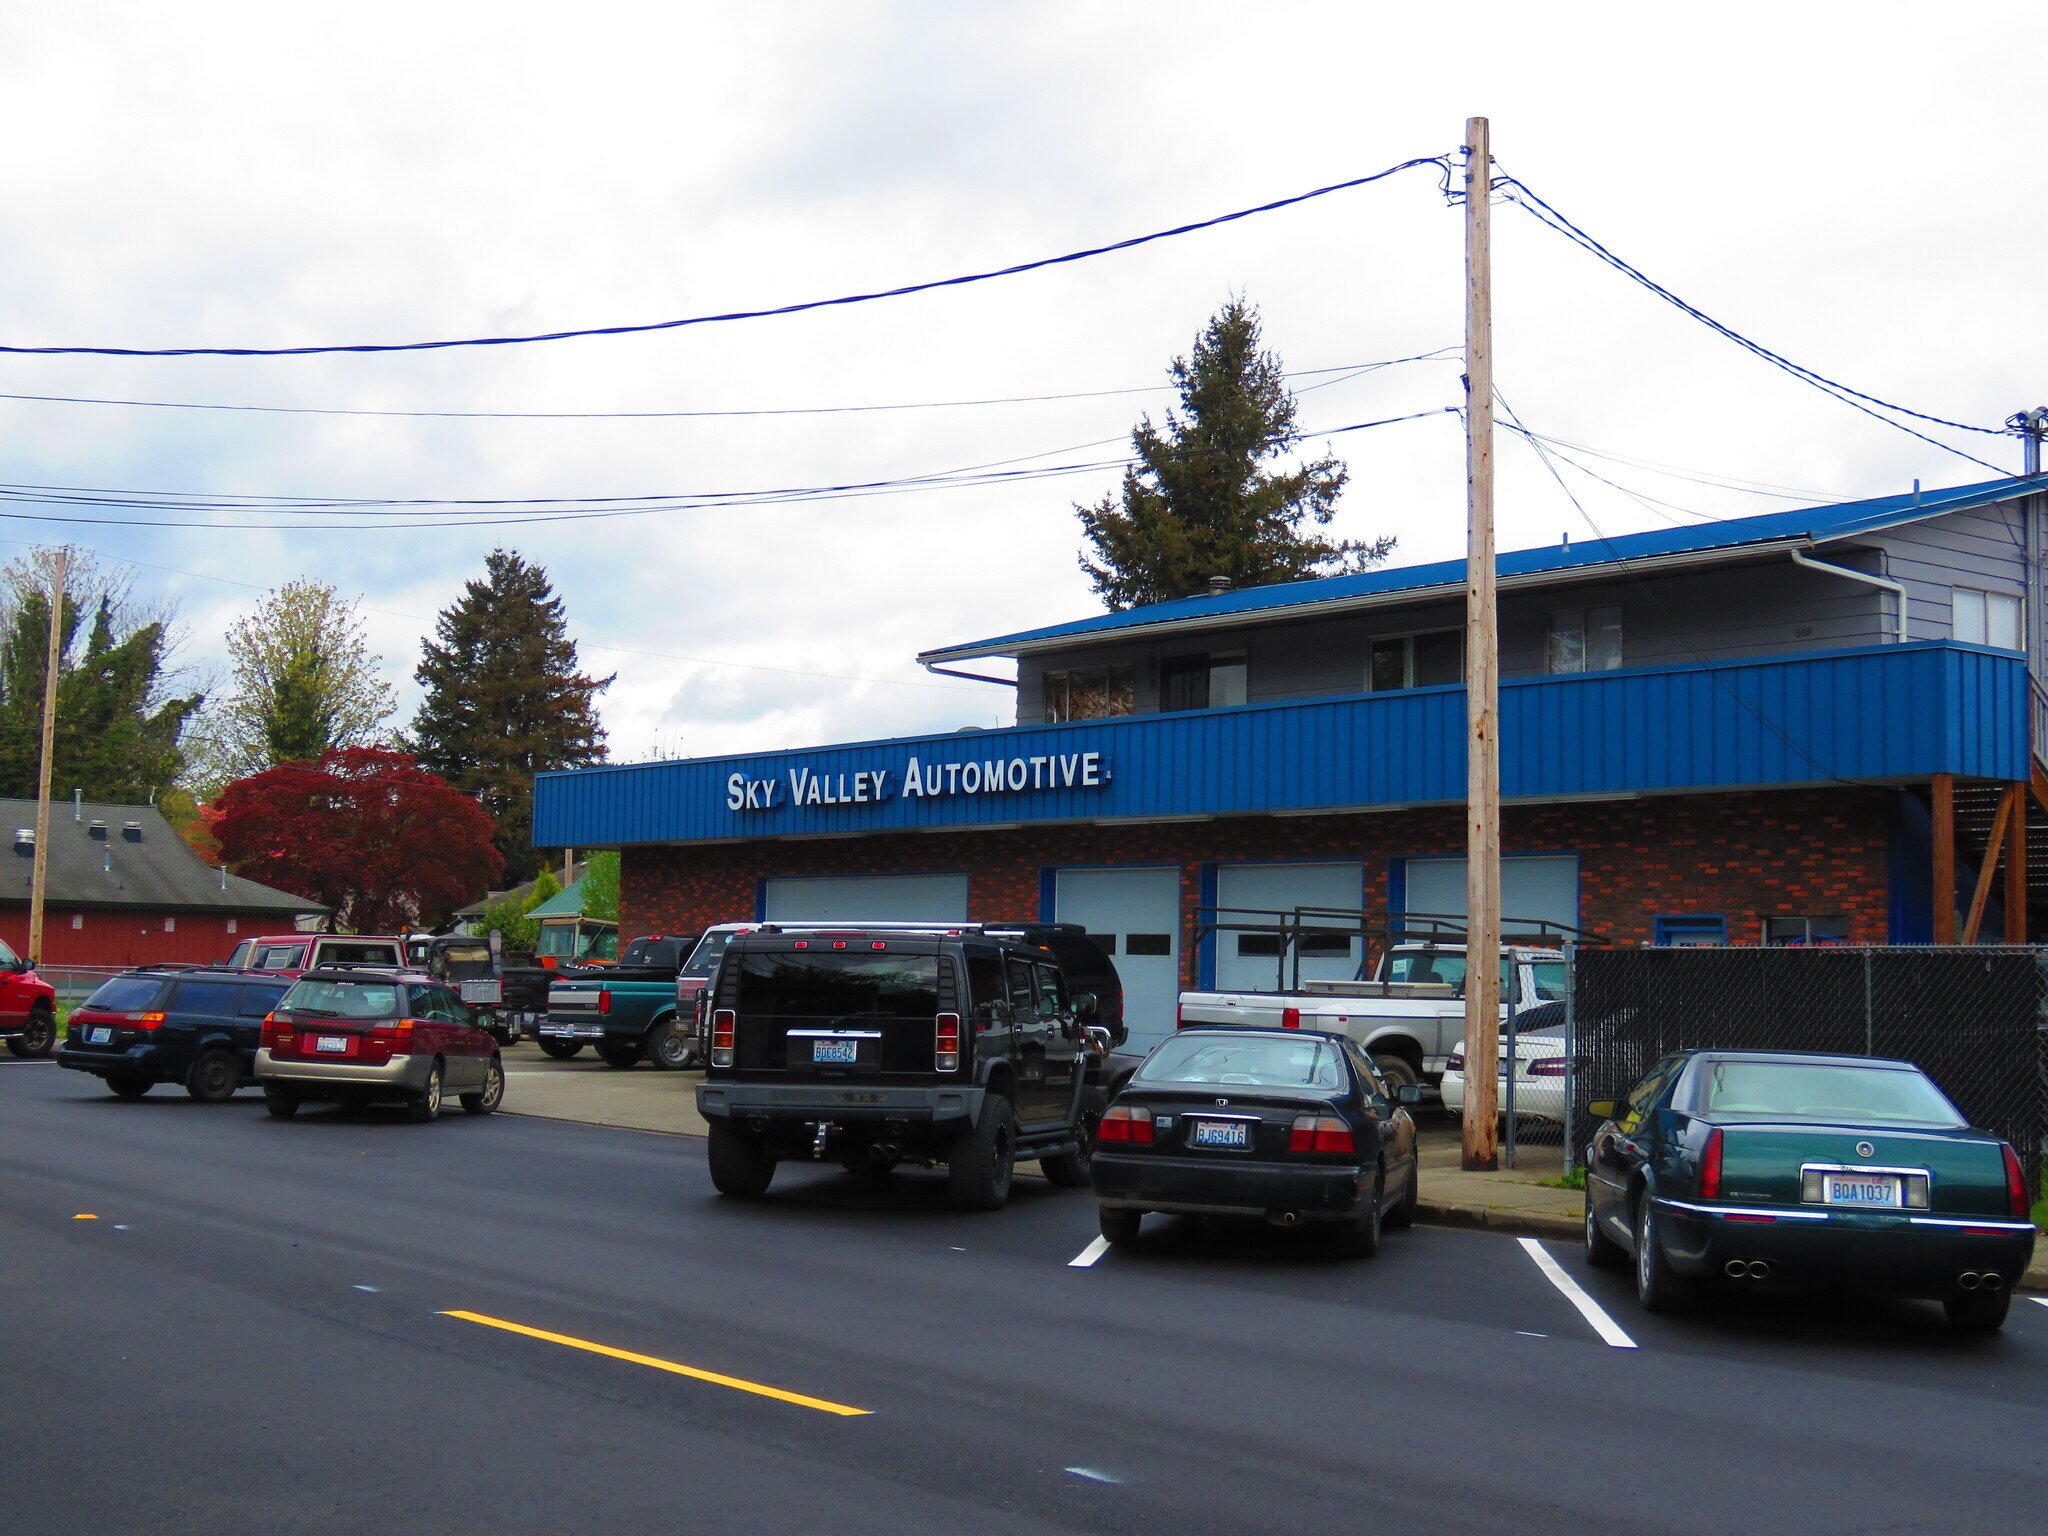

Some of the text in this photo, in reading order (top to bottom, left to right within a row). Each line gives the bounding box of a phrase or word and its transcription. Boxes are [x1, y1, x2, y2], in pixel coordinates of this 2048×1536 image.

[727, 752, 1100, 811] SKY VALLEY AUTOMOTIVE
[1198, 1129, 1244, 1144] BJG9416
[1833, 1183, 1892, 1201] BQA1037
